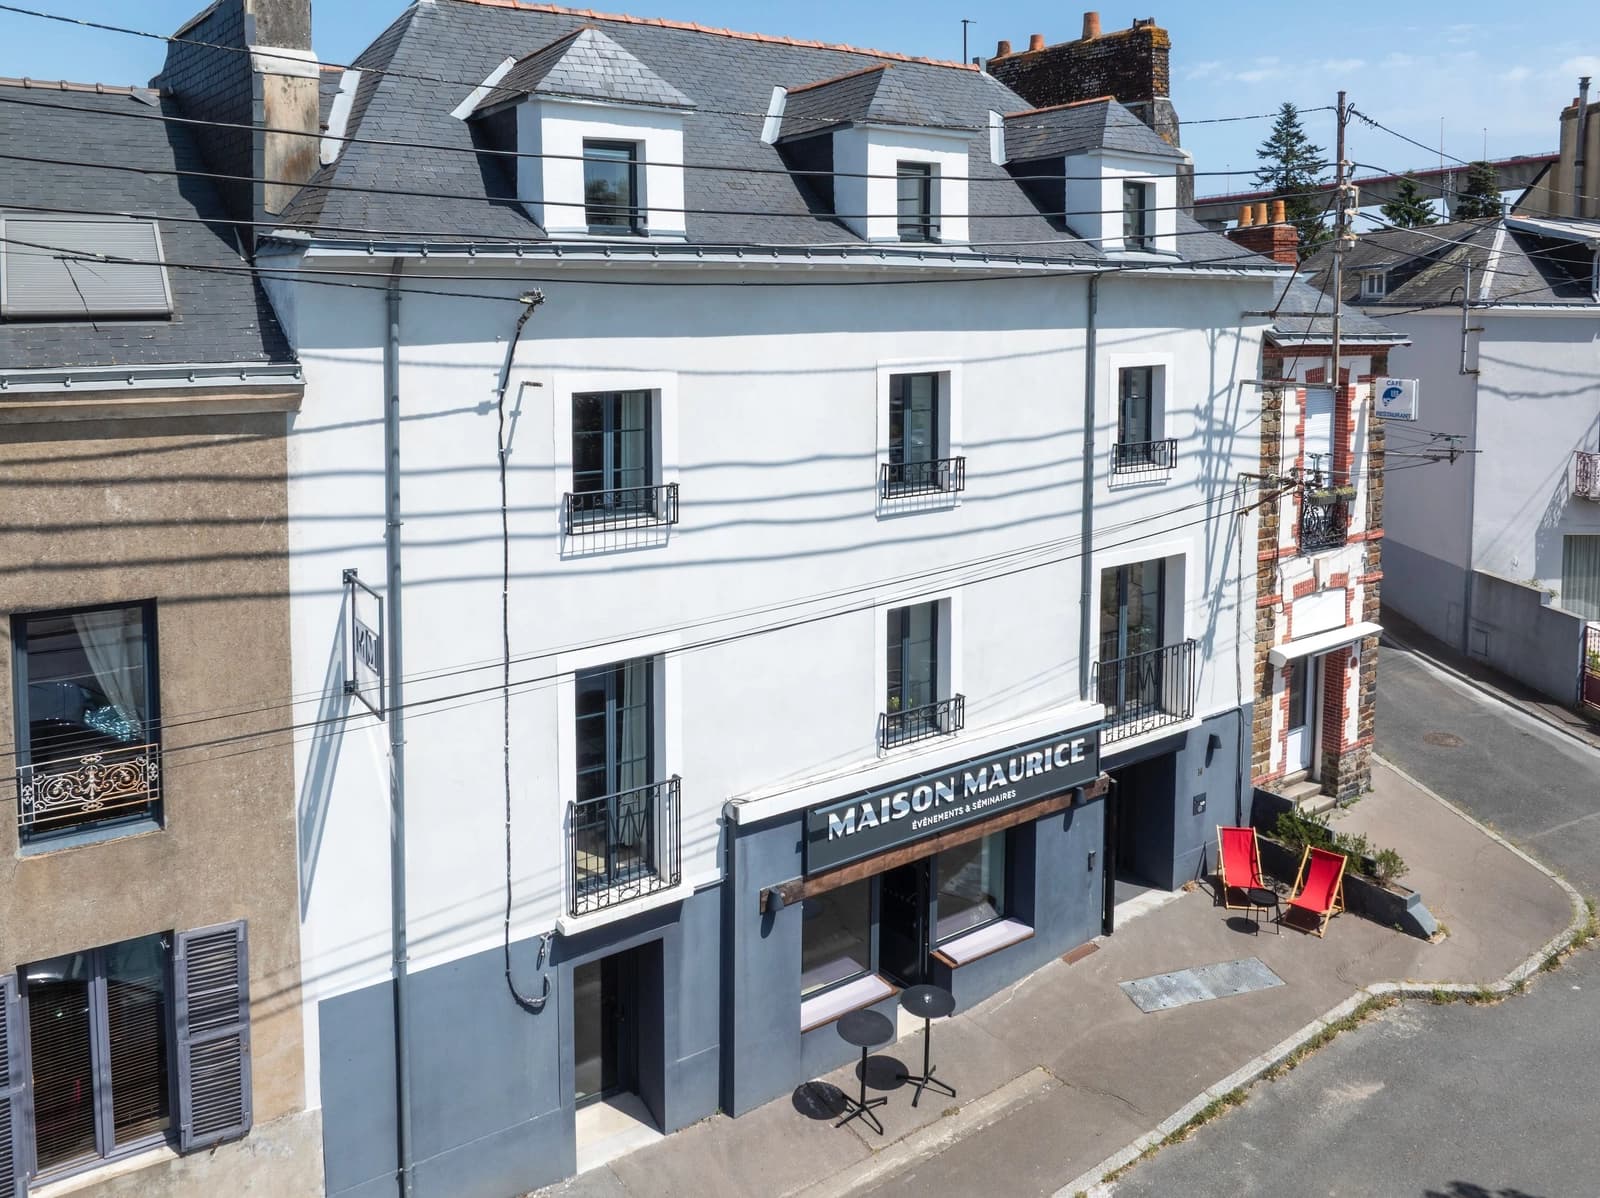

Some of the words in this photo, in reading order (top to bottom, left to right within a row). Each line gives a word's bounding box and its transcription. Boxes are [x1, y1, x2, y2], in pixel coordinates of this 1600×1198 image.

[828, 776, 955, 840] MAISON
[964, 737, 1085, 798] MAURICE
[911, 807, 963, 830] ÉVÉNEMENTS
[965, 804, 971, 813] &
[972, 789, 1017, 809] SÉMINAIRES
